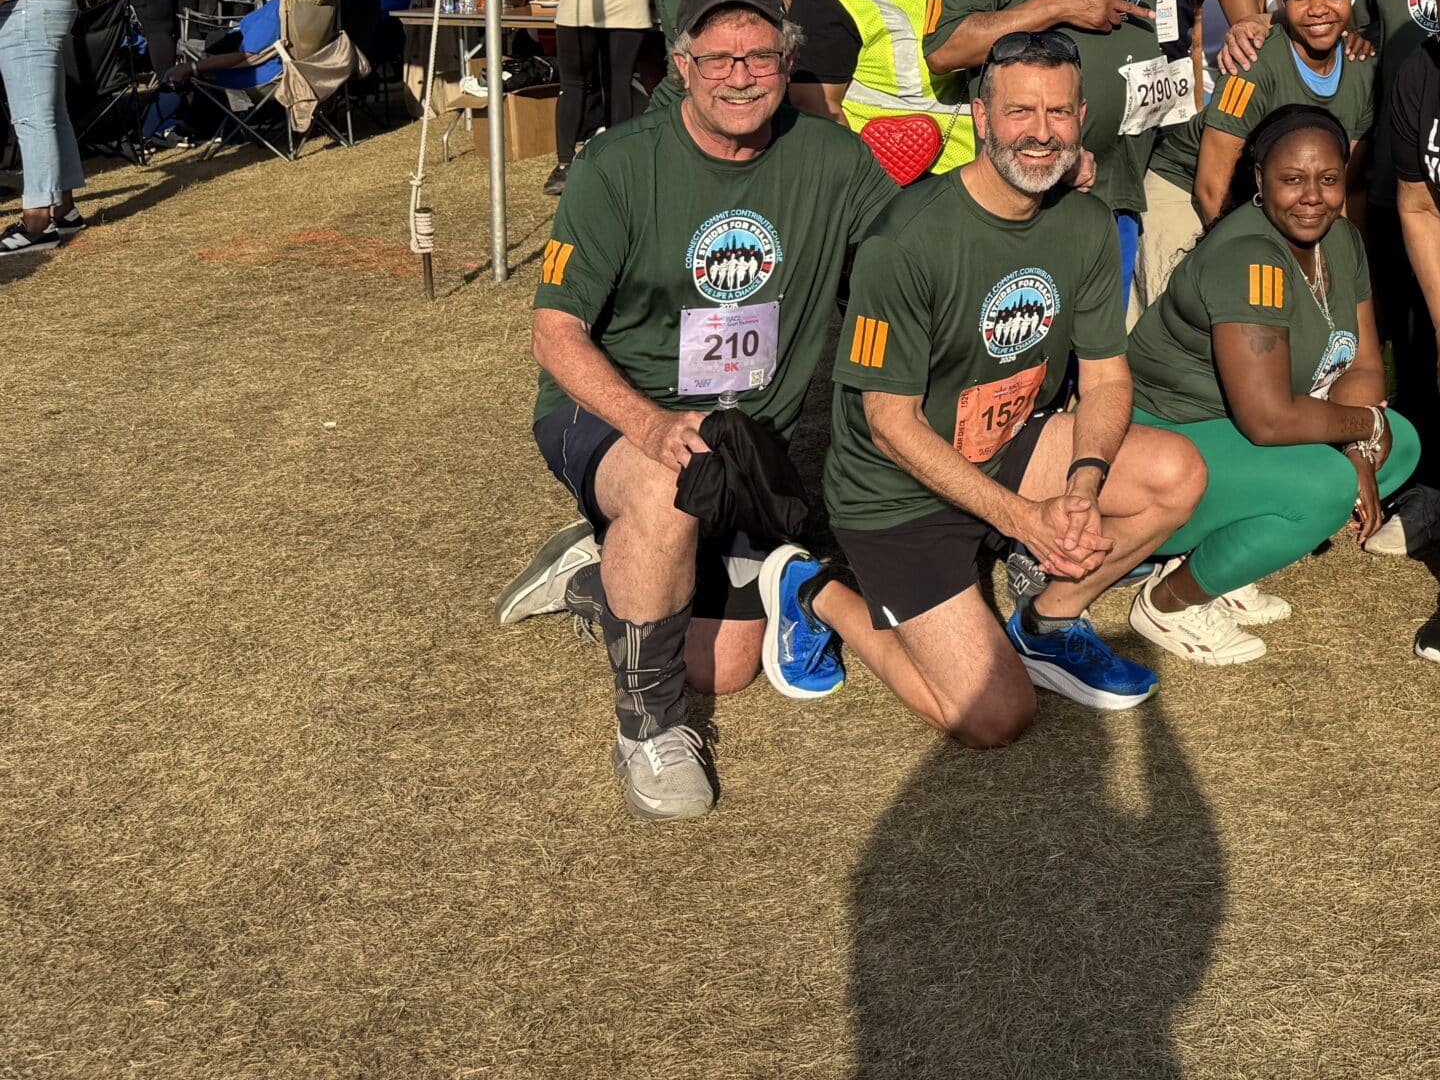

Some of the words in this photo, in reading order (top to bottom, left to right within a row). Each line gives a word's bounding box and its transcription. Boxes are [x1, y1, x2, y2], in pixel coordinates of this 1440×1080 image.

[1138, 77, 1172, 107] 2190
[699, 223, 729, 256] STRIDES
[729, 221, 750, 229] FOR
[749, 224, 771, 251] PEACE
[712, 290, 727, 299] LIFE
[727, 291, 734, 299] A
[734, 278, 761, 298] CHANCE
[1018, 280, 1034, 288] FOR
[1034, 281, 1053, 306] PEACE
[703, 330, 759, 361] 210
[724, 362, 740, 372] 8K
[982, 394, 1031, 431] 152
